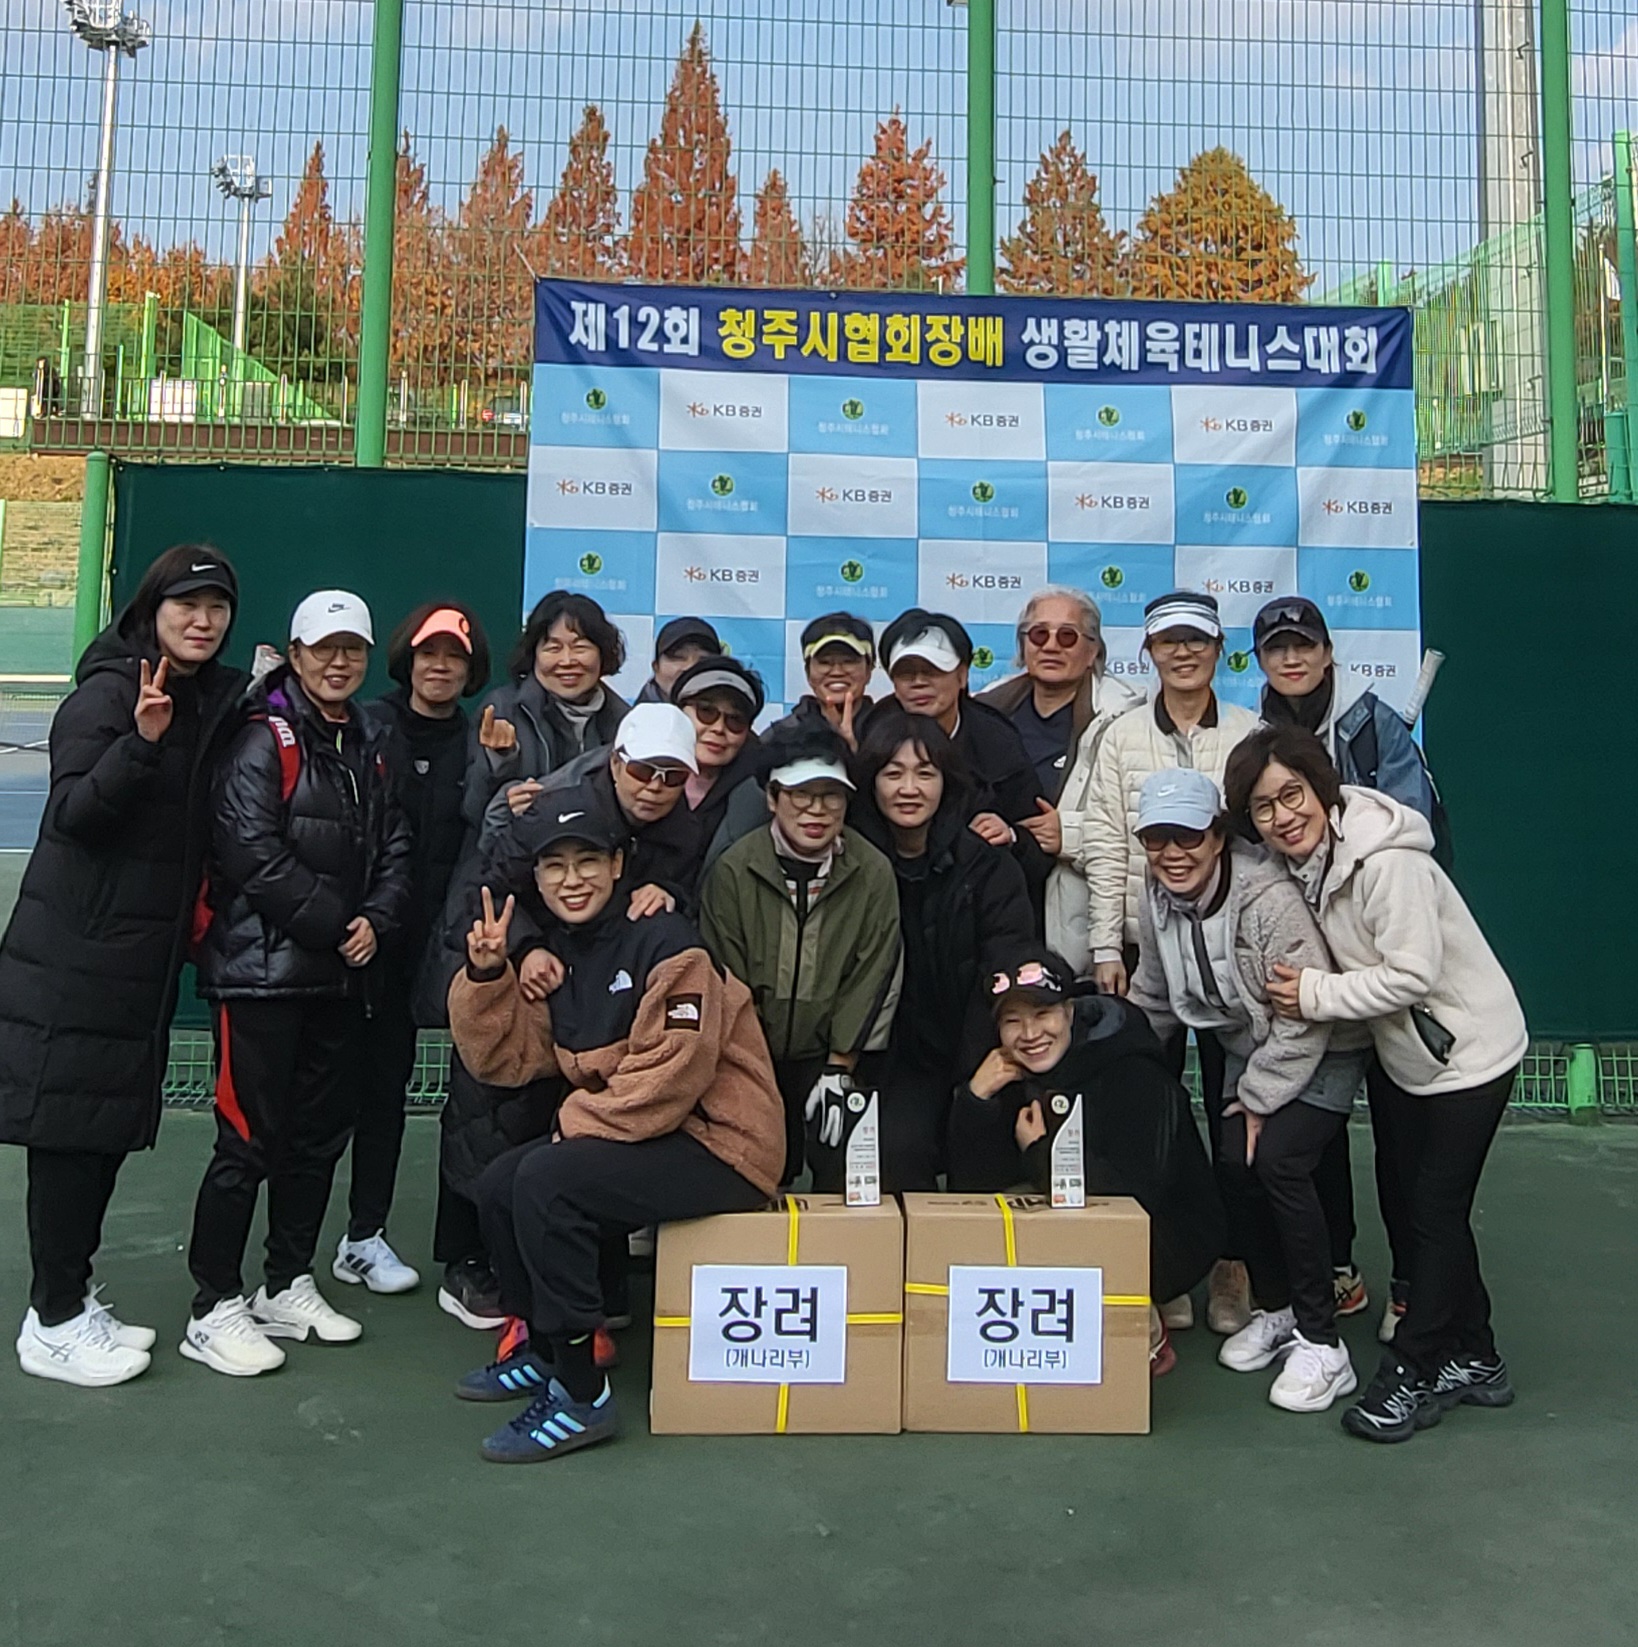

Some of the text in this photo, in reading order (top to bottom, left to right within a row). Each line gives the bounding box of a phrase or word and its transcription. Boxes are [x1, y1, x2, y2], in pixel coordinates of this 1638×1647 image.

[568, 300, 1381, 375] 제12회 청주시협회장배 생활체육테니스대회
[718, 1286, 820, 1345] 장려
[975, 1287, 1077, 1346] 장려
